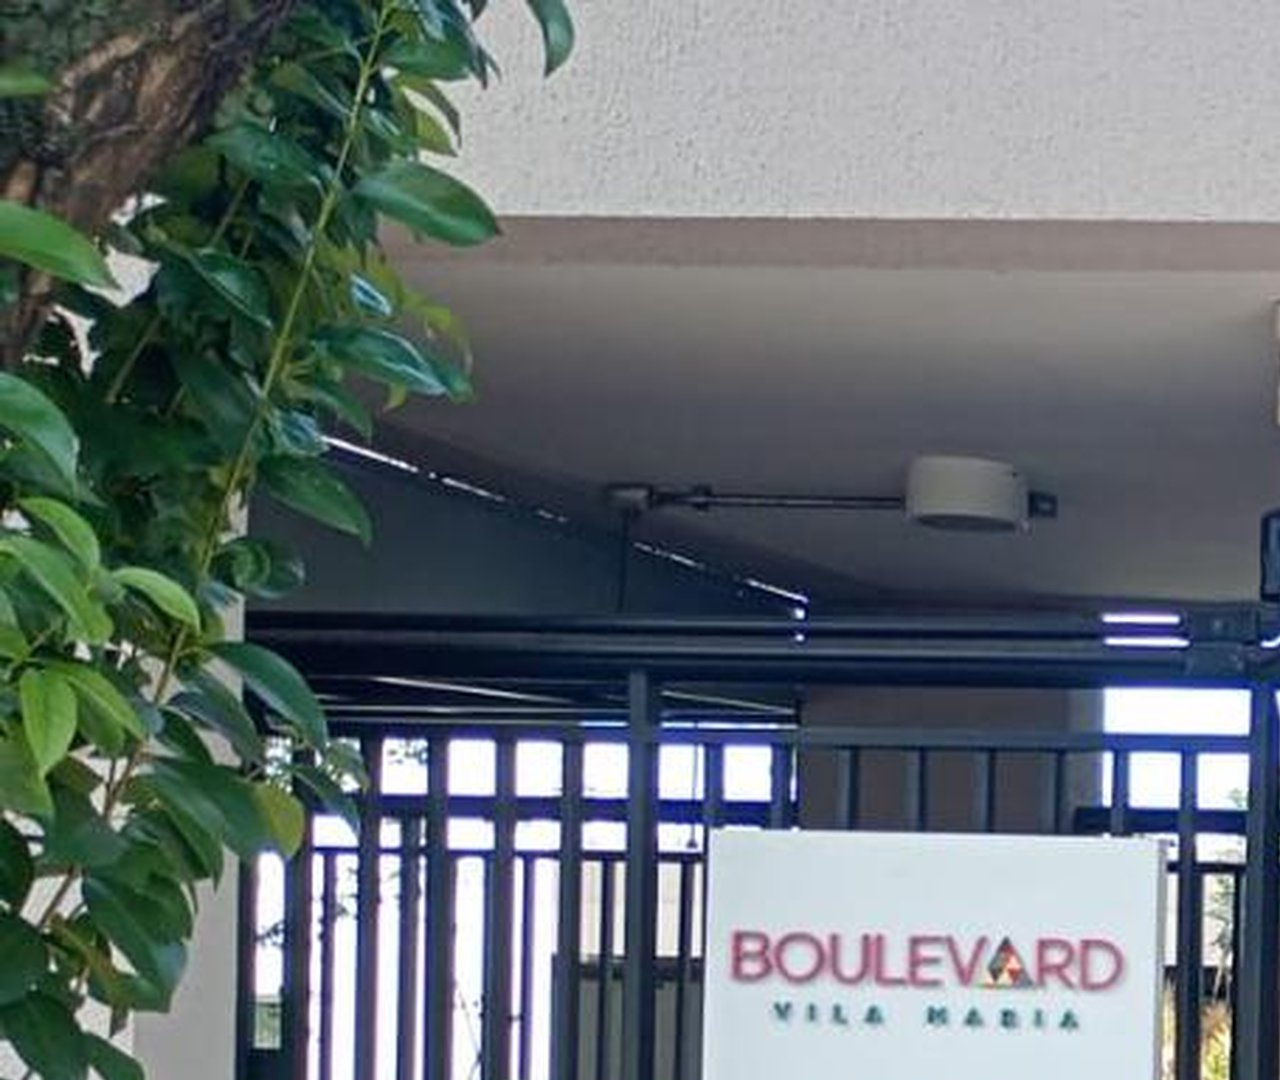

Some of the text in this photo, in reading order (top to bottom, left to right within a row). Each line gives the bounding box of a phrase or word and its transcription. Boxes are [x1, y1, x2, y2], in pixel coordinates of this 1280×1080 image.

[731, 930, 1125, 992] BOULEVARD
[774, 1002, 1080, 1030] VILA MARIA
